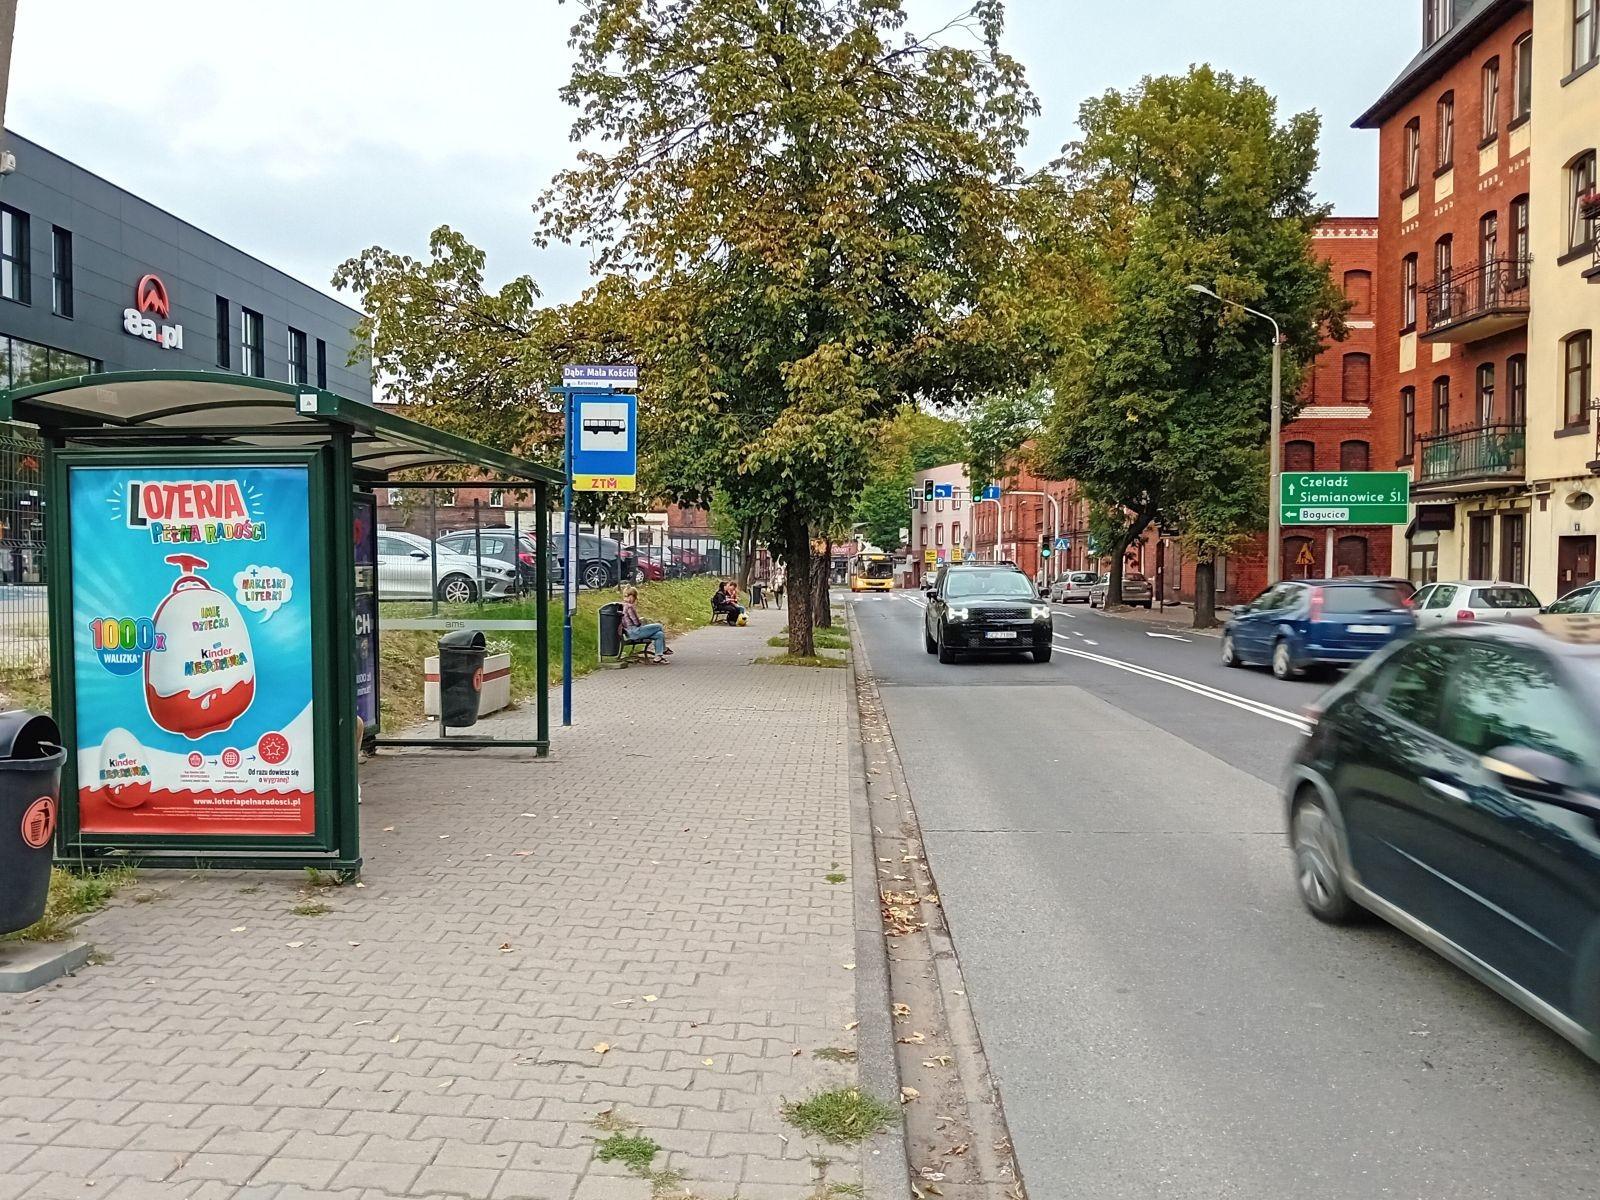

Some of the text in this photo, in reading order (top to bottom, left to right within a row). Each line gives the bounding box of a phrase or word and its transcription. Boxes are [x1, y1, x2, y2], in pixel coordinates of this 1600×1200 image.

[123, 308, 183, 350] 8a.pl
[564, 367, 585, 379] Dąbr.
[608, 367, 637, 378] Kościół
[591, 477, 617, 489] ZTM
[1300, 476, 1349, 488] Czeladź
[1300, 487, 1405, 503] Siemianowice Śl.
[129, 483, 245, 527] LOTERIA
[1302, 510, 1346, 521] Bogucice
[150, 519, 266, 543] PEŁNA RADOŚCI
[245, 591, 283, 602] LITERKI
[268, 768, 290, 776] dowiesz
